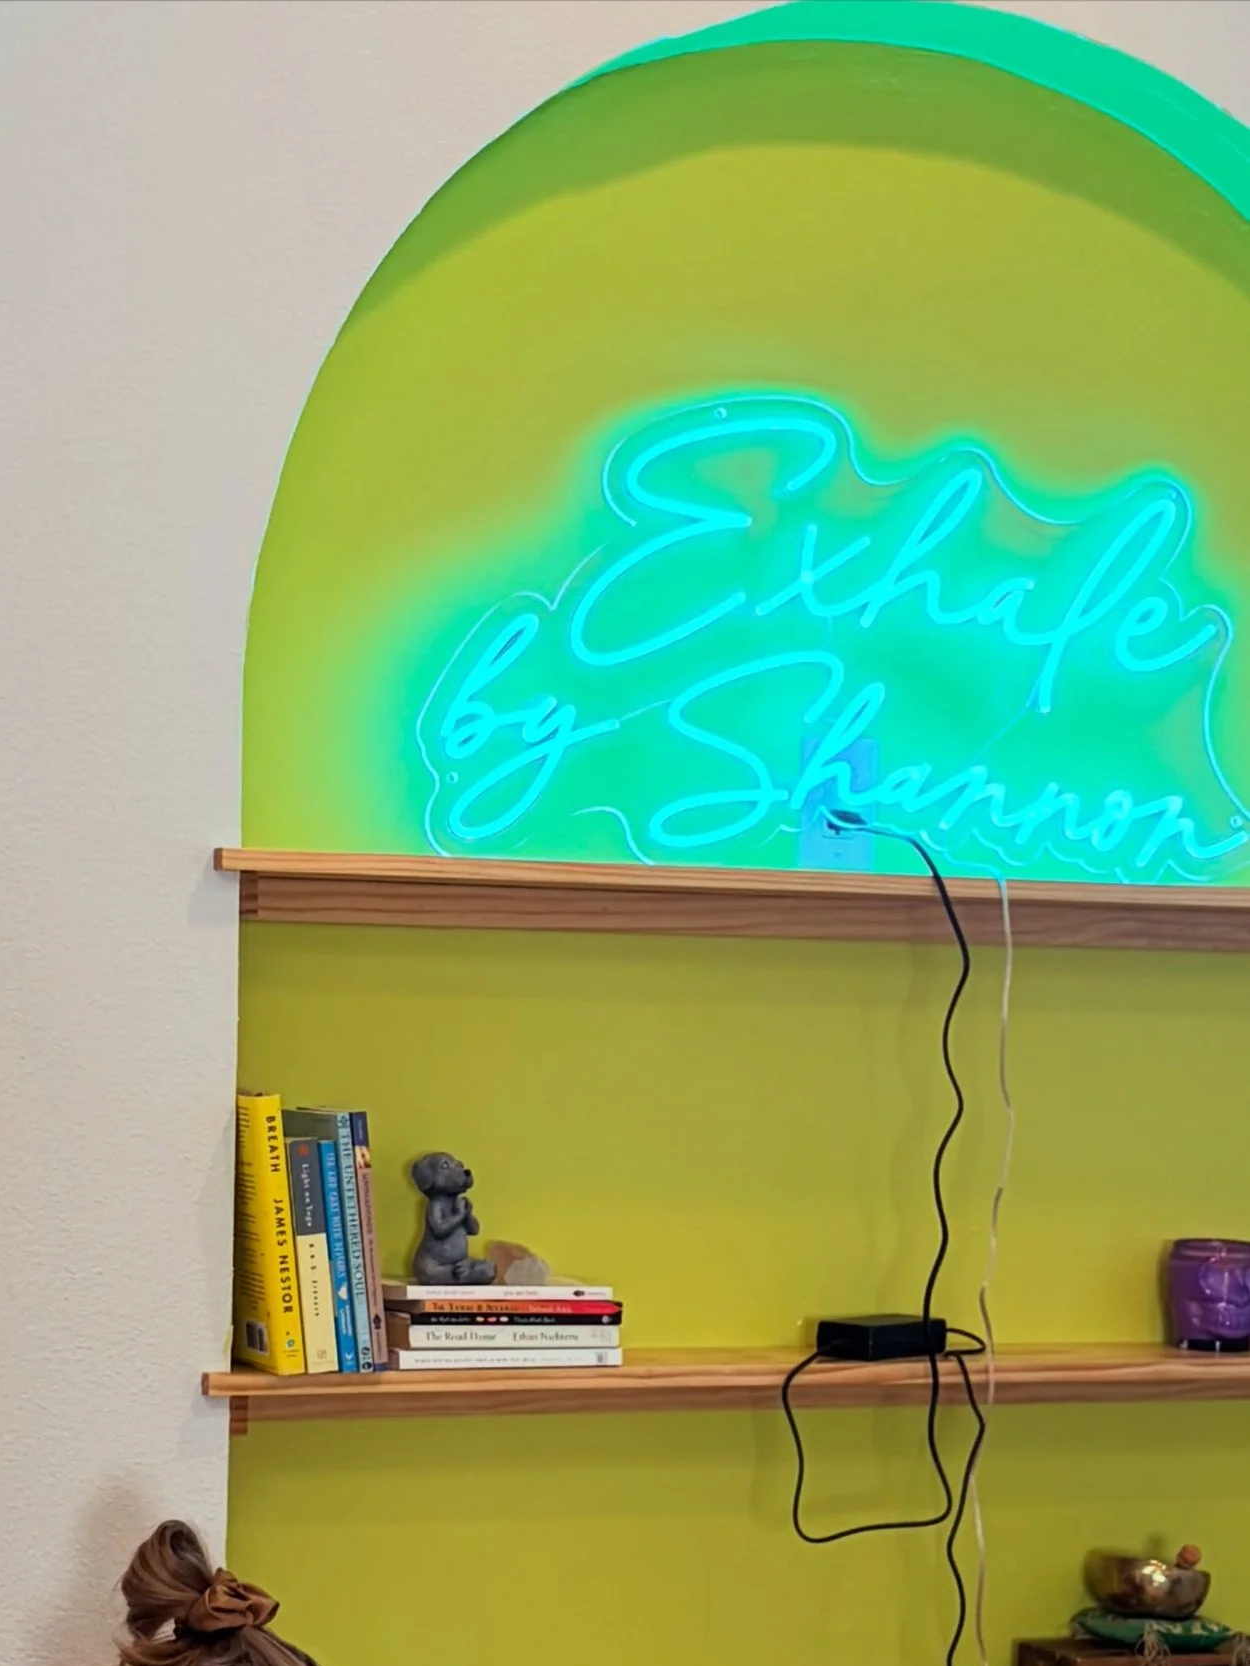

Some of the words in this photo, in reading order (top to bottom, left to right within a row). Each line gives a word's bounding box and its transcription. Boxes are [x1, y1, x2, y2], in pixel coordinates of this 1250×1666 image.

[571, 419, 1217, 713] Exhale
[441, 613, 620, 839] by
[650, 652, 1248, 868] Shannon
[265, 1115, 281, 1173] BREATH
[300, 1163, 311, 1189] Light
[274, 1198, 287, 1247] JAMES
[278, 1254, 293, 1314] NESTOR
[353, 1263, 365, 1297] SOUL
